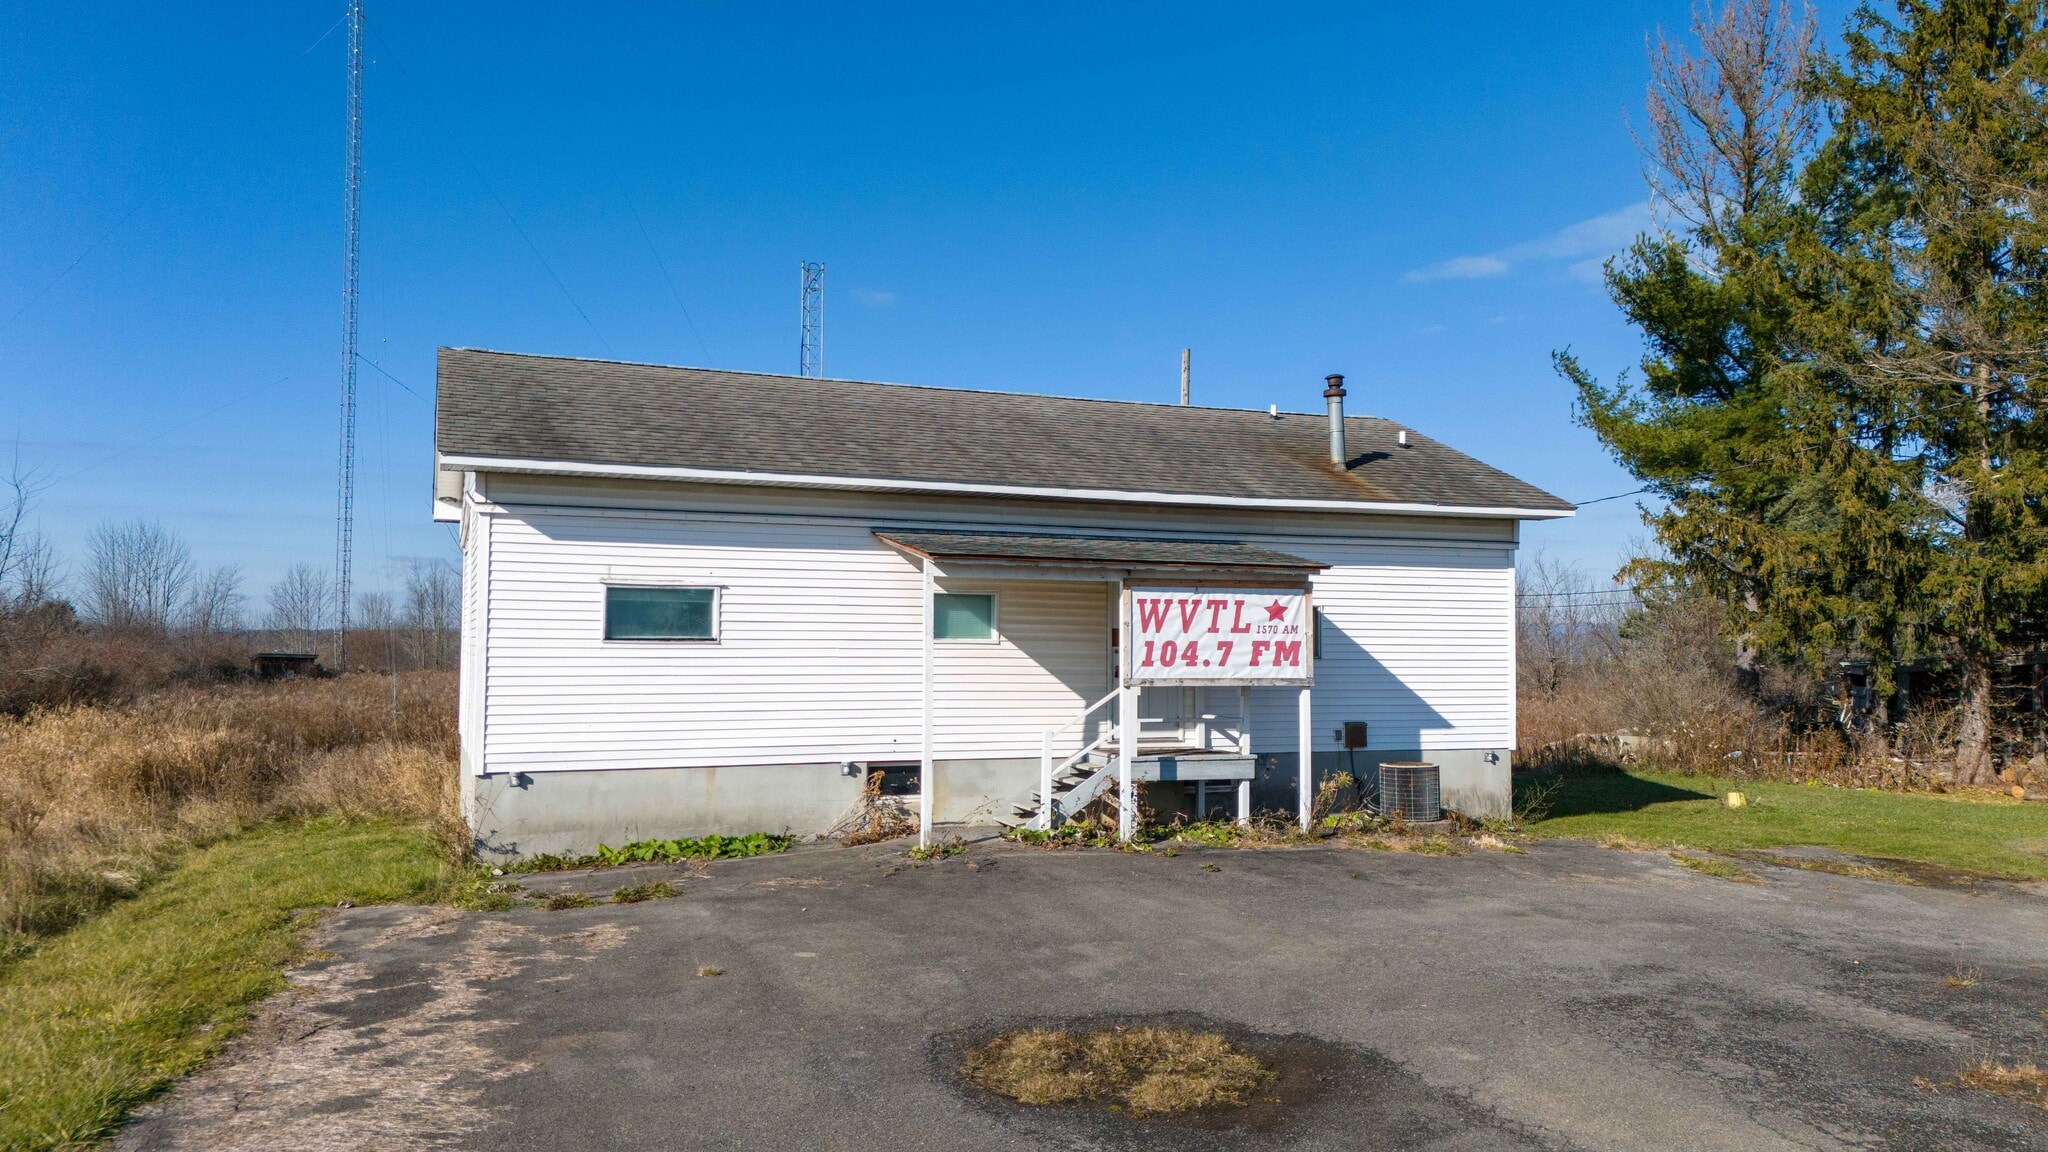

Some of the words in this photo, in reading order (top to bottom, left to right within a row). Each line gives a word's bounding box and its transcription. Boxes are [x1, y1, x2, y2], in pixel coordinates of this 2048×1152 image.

[1137, 598, 1251, 634] WVTL
[1256, 624, 1278, 635] 1570
[1282, 625, 1299, 635] AM
[1141, 640, 1233, 668] 104.7
[1249, 640, 1301, 667] FM
